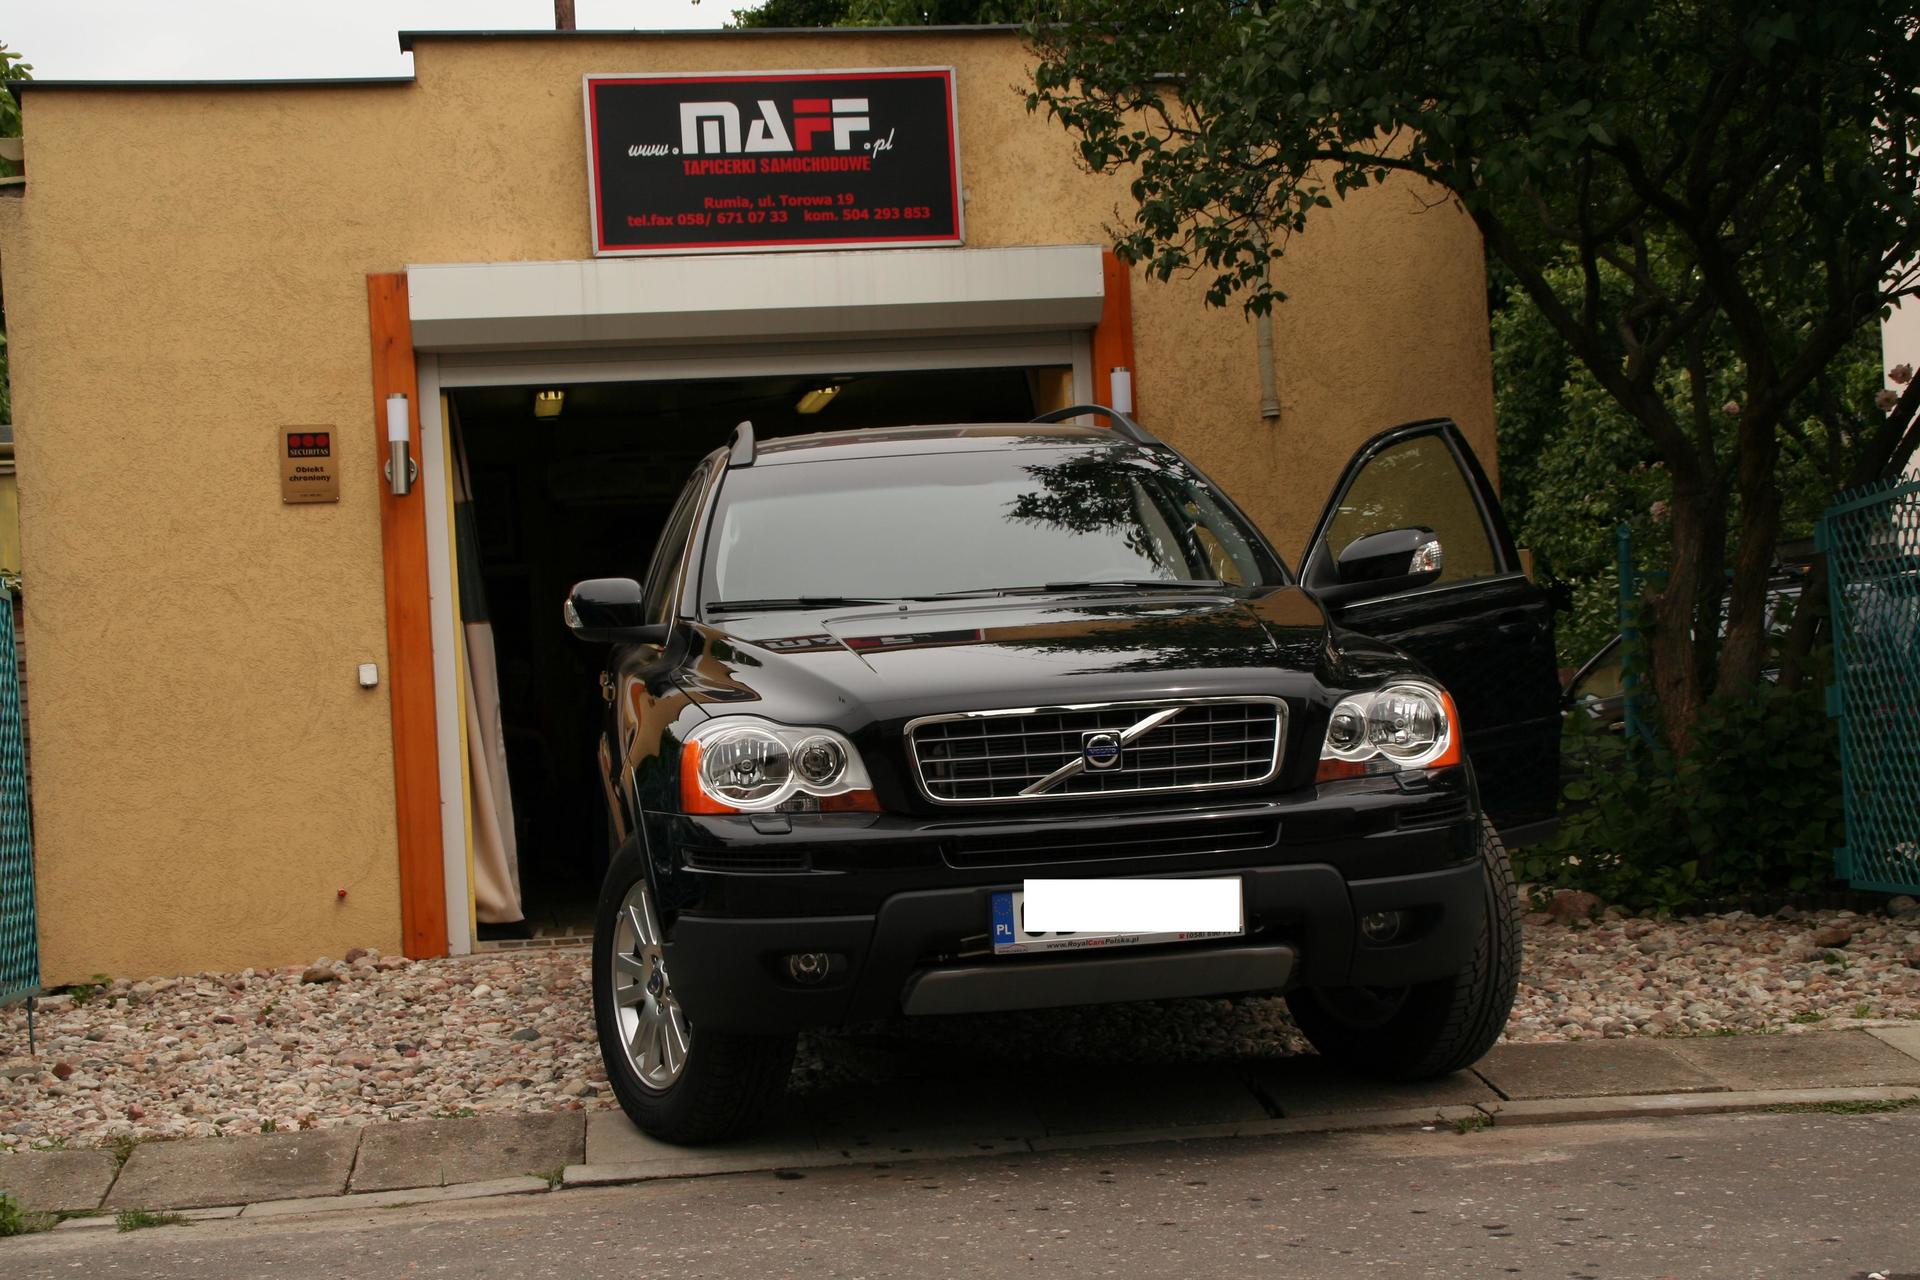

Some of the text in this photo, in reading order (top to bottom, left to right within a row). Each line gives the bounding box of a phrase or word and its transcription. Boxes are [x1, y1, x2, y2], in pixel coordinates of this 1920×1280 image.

[683, 155, 871, 176] TAPICERKI SAMOCHODOWE
[703, 193, 855, 209] Rumia, ul. Torowa 19
[627, 206, 931, 227] tel.fax 058/ 671 07 33 kom. 504 293 853
[289, 448, 328, 456] SECURITAS
[996, 924, 1011, 936] PL
